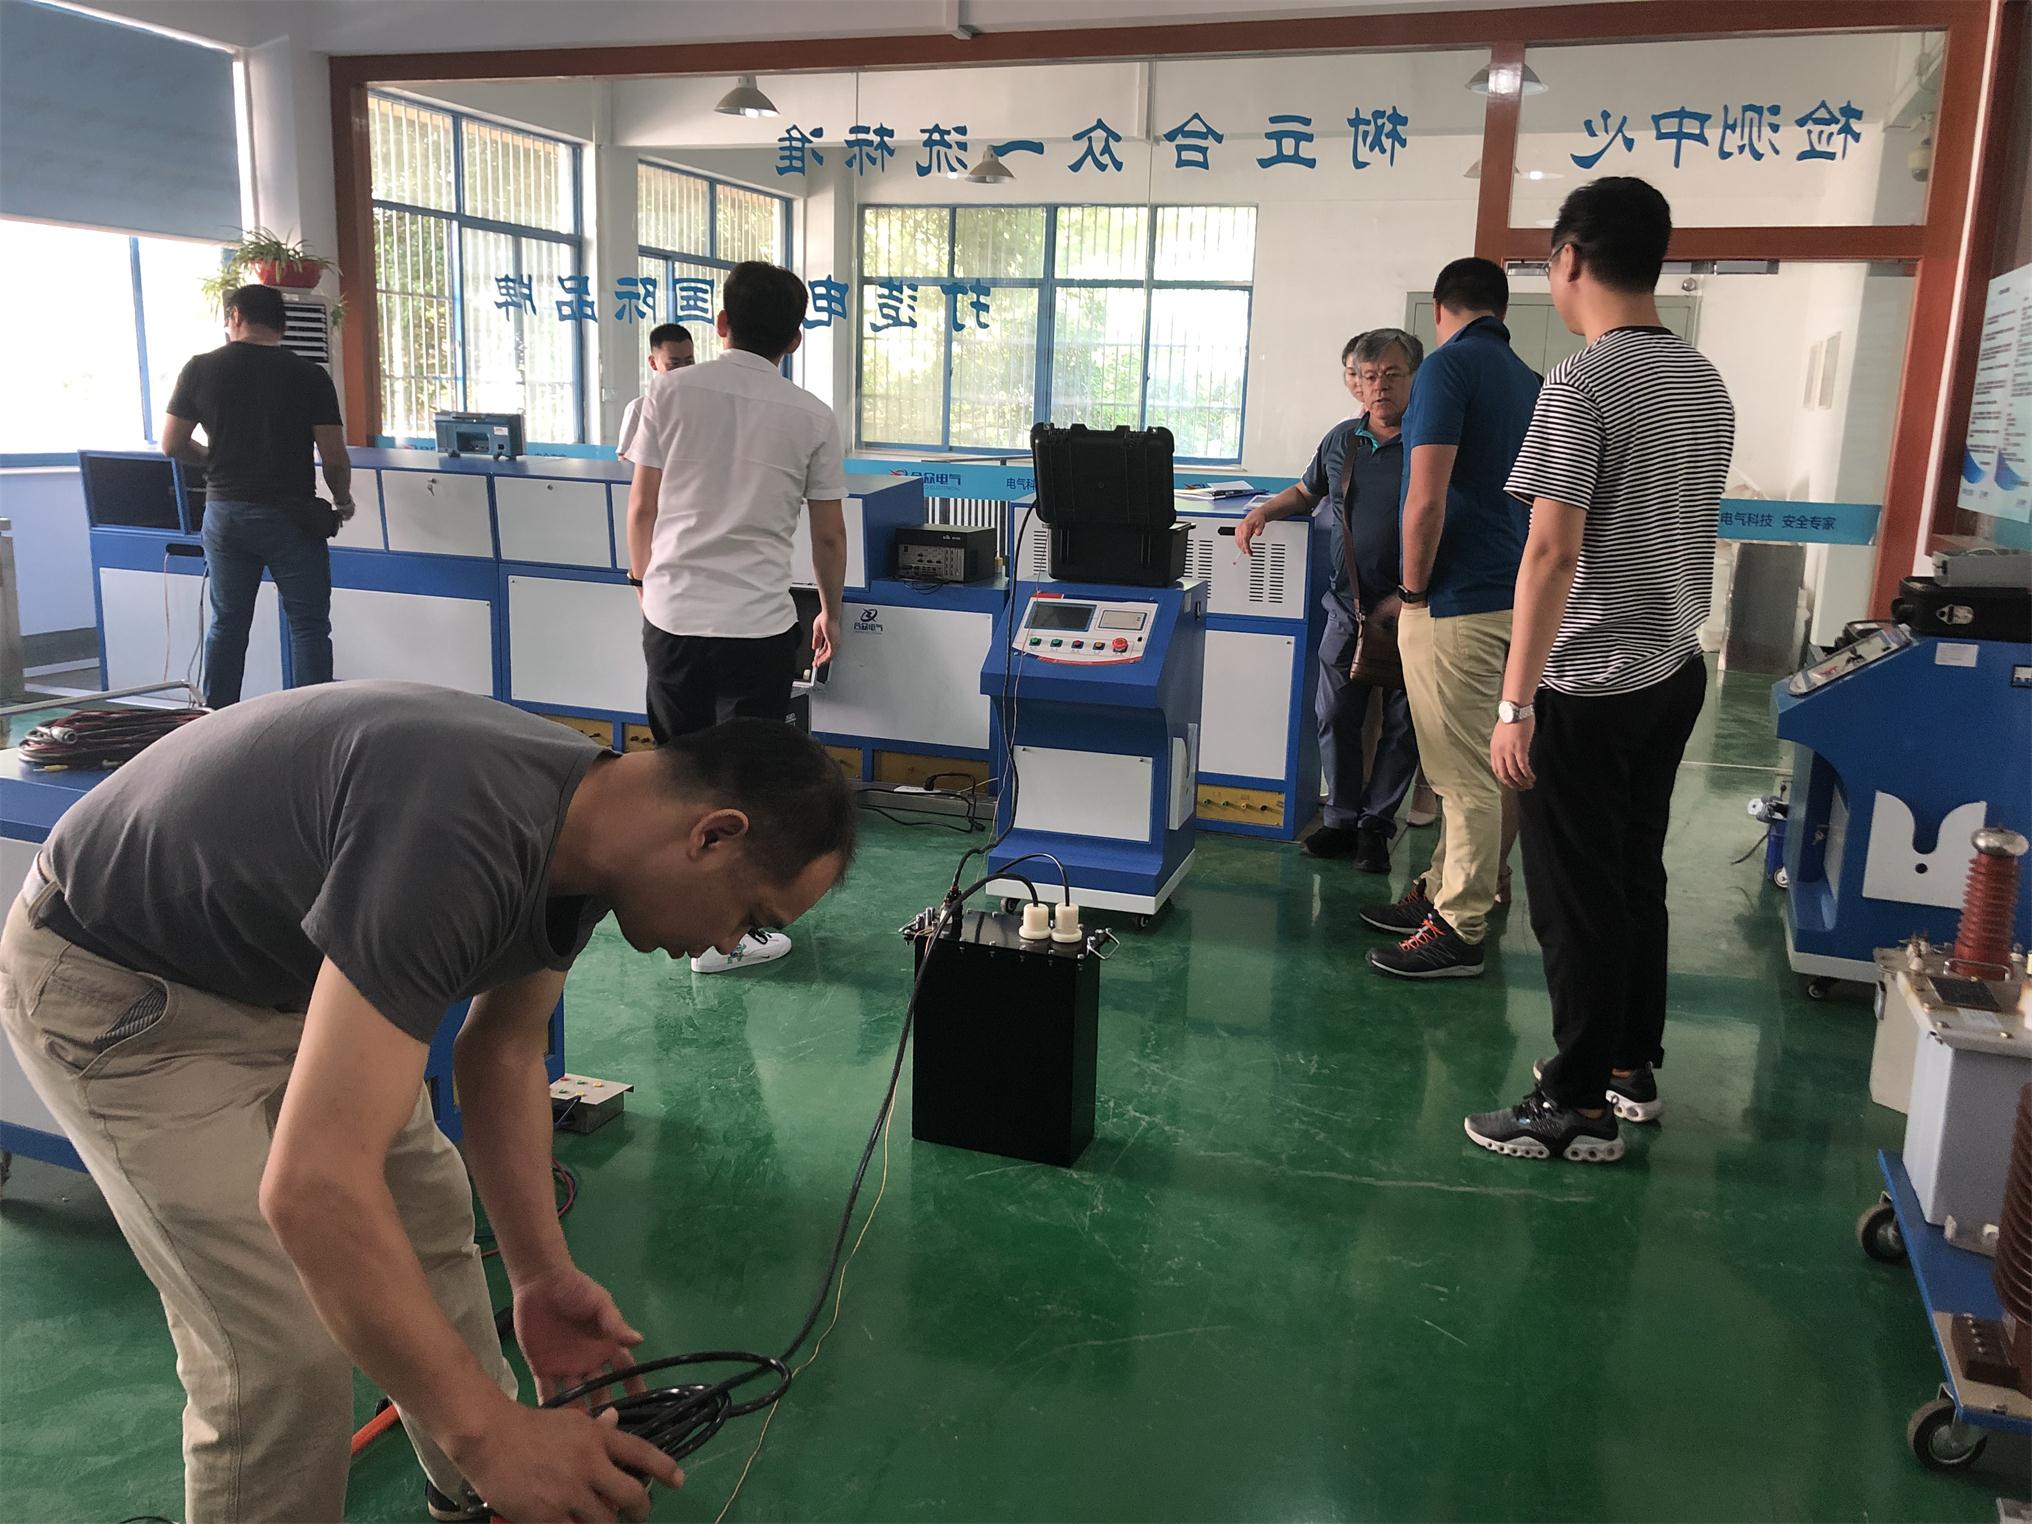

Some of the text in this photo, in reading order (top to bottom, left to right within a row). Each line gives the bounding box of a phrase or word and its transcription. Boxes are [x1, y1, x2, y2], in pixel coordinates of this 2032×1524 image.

[1720, 511, 1836, 530] 电气科技 安全专家
